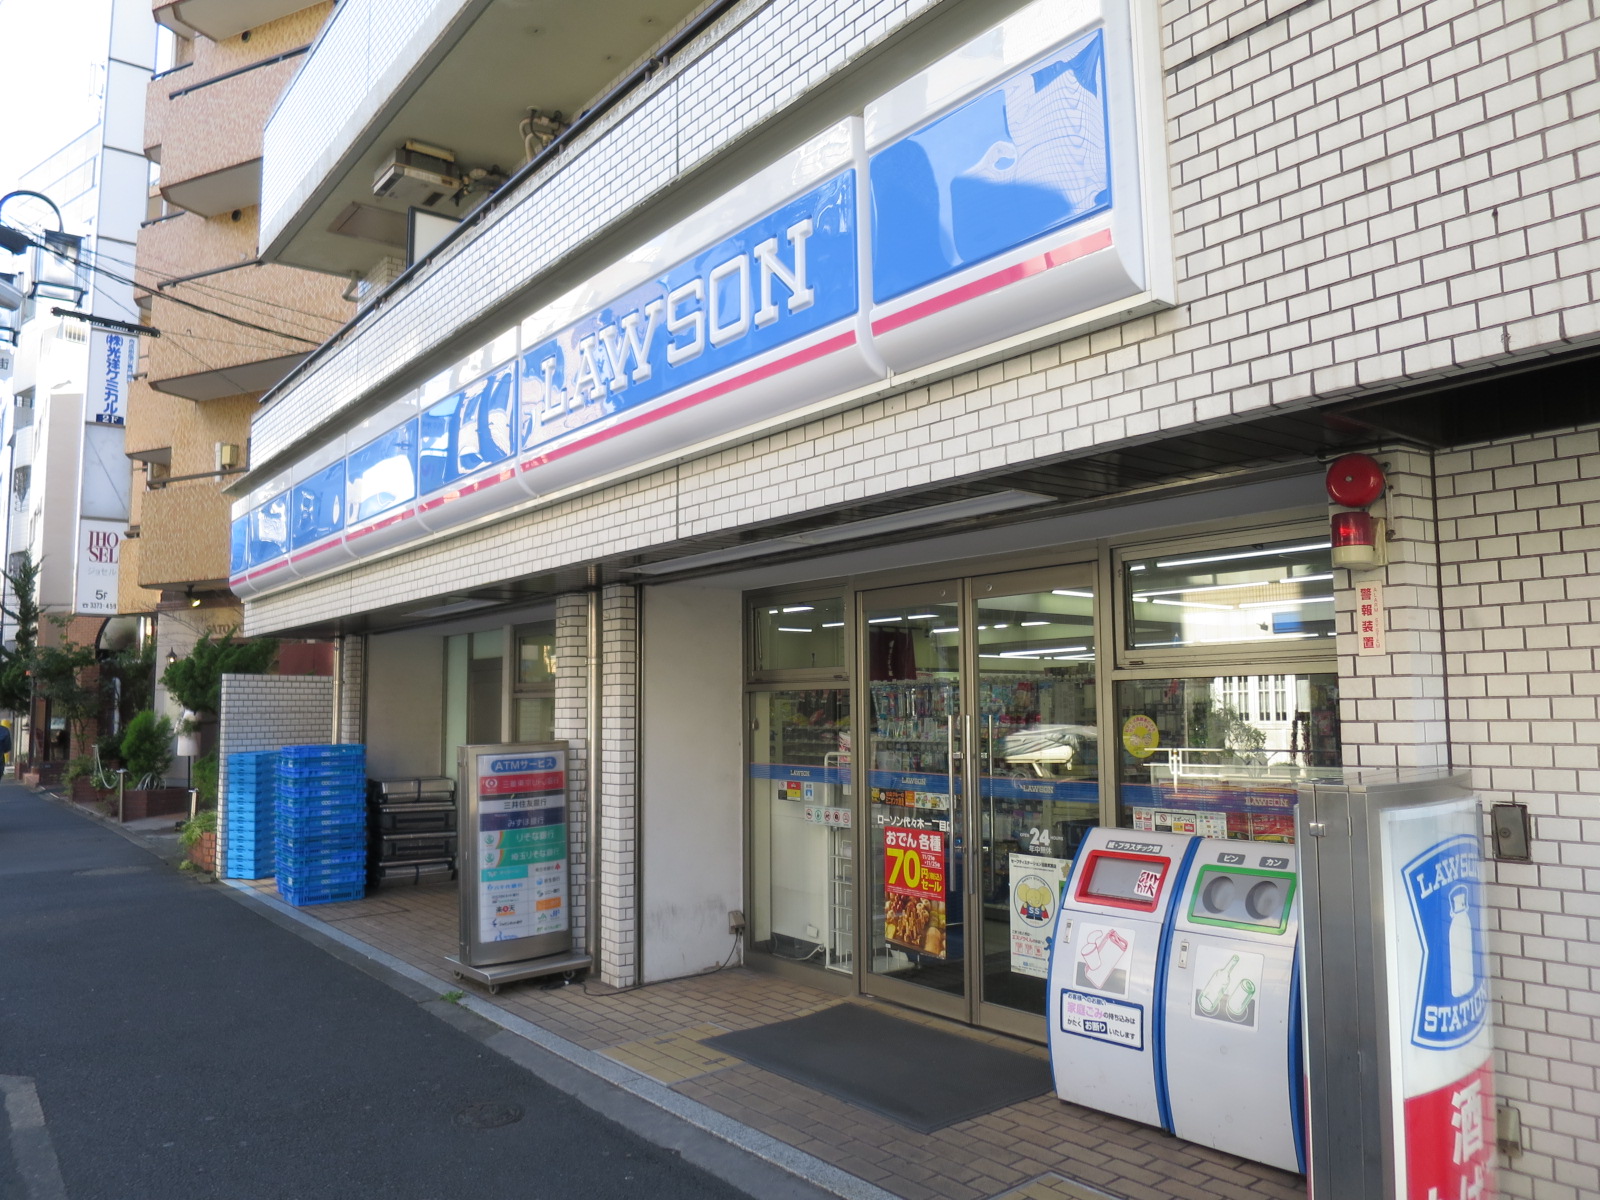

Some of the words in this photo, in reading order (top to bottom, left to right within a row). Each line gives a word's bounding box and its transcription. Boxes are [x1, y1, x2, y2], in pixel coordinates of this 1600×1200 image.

[540, 217, 815, 424] LAWSON
[95, 589, 108, 600] 5F
[1360, 588, 1374, 649] 警報装置
[495, 758, 554, 771] ATMサービス
[1022, 784, 1054, 794] LAWSON
[504, 798, 547, 810] 三井住友銀行
[1245, 796, 1290, 808] LAWSON
[886, 831, 917, 848] おでん
[919, 833, 942, 852] 各種
[1029, 827, 1051, 846] 24
[886, 847, 921, 888] 70
[1265, 858, 1282, 867] カン
[921, 879, 942, 892] セール
[1028, 906, 1040, 915] SS
[1067, 1018, 1082, 1028] かたく
[1084, 1020, 1107, 1033] お断り
[1108, 1028, 1136, 1040] いたします
[1451, 1079, 1484, 1166] 酒
